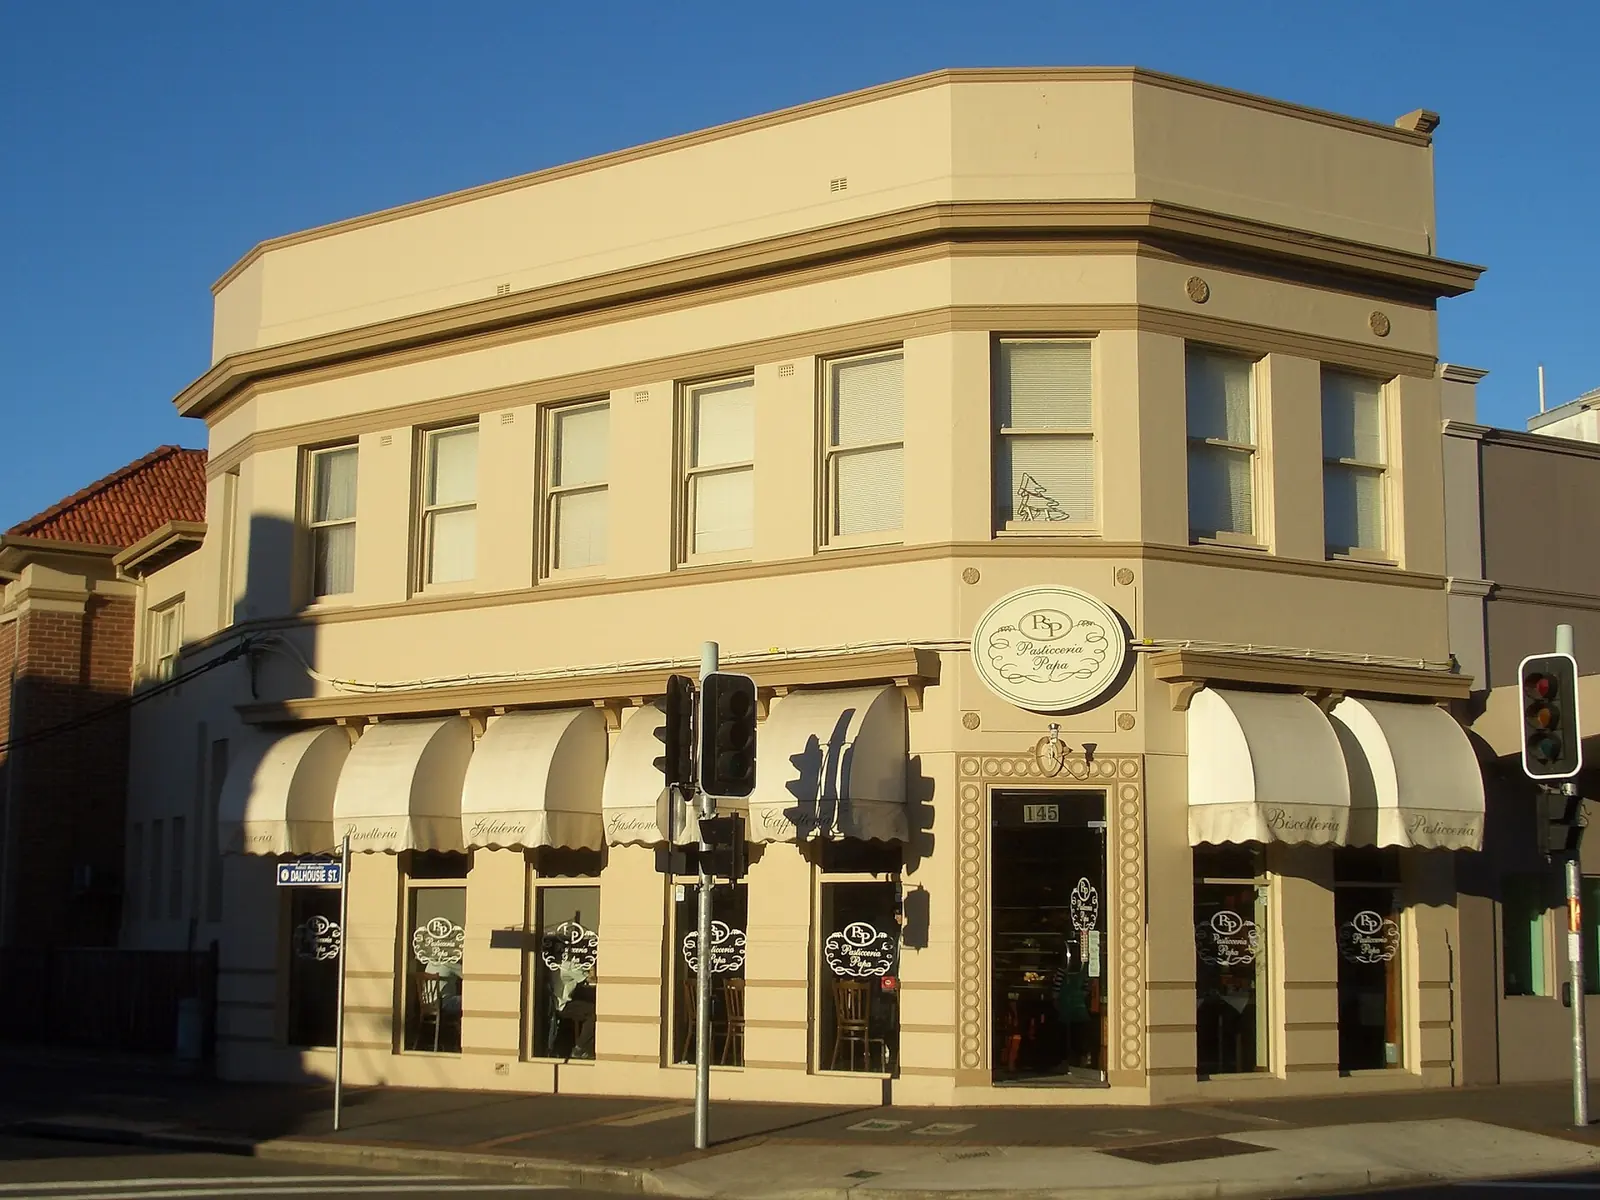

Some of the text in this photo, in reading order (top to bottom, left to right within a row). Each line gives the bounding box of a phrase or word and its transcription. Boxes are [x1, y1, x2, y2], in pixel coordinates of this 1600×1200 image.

[1016, 641, 1085, 657] Pasticceria
[1032, 656, 1069, 674] Papa
[1026, 806, 1057, 820] 145
[1267, 808, 1340, 831] Biscotteria
[469, 815, 526, 838] Gelateria
[1408, 813, 1474, 836] Pasticceria
[290, 869, 326, 882] DALHOUSIE
[841, 944, 881, 957] Pasticceria
[850, 956, 871, 971] Papa
